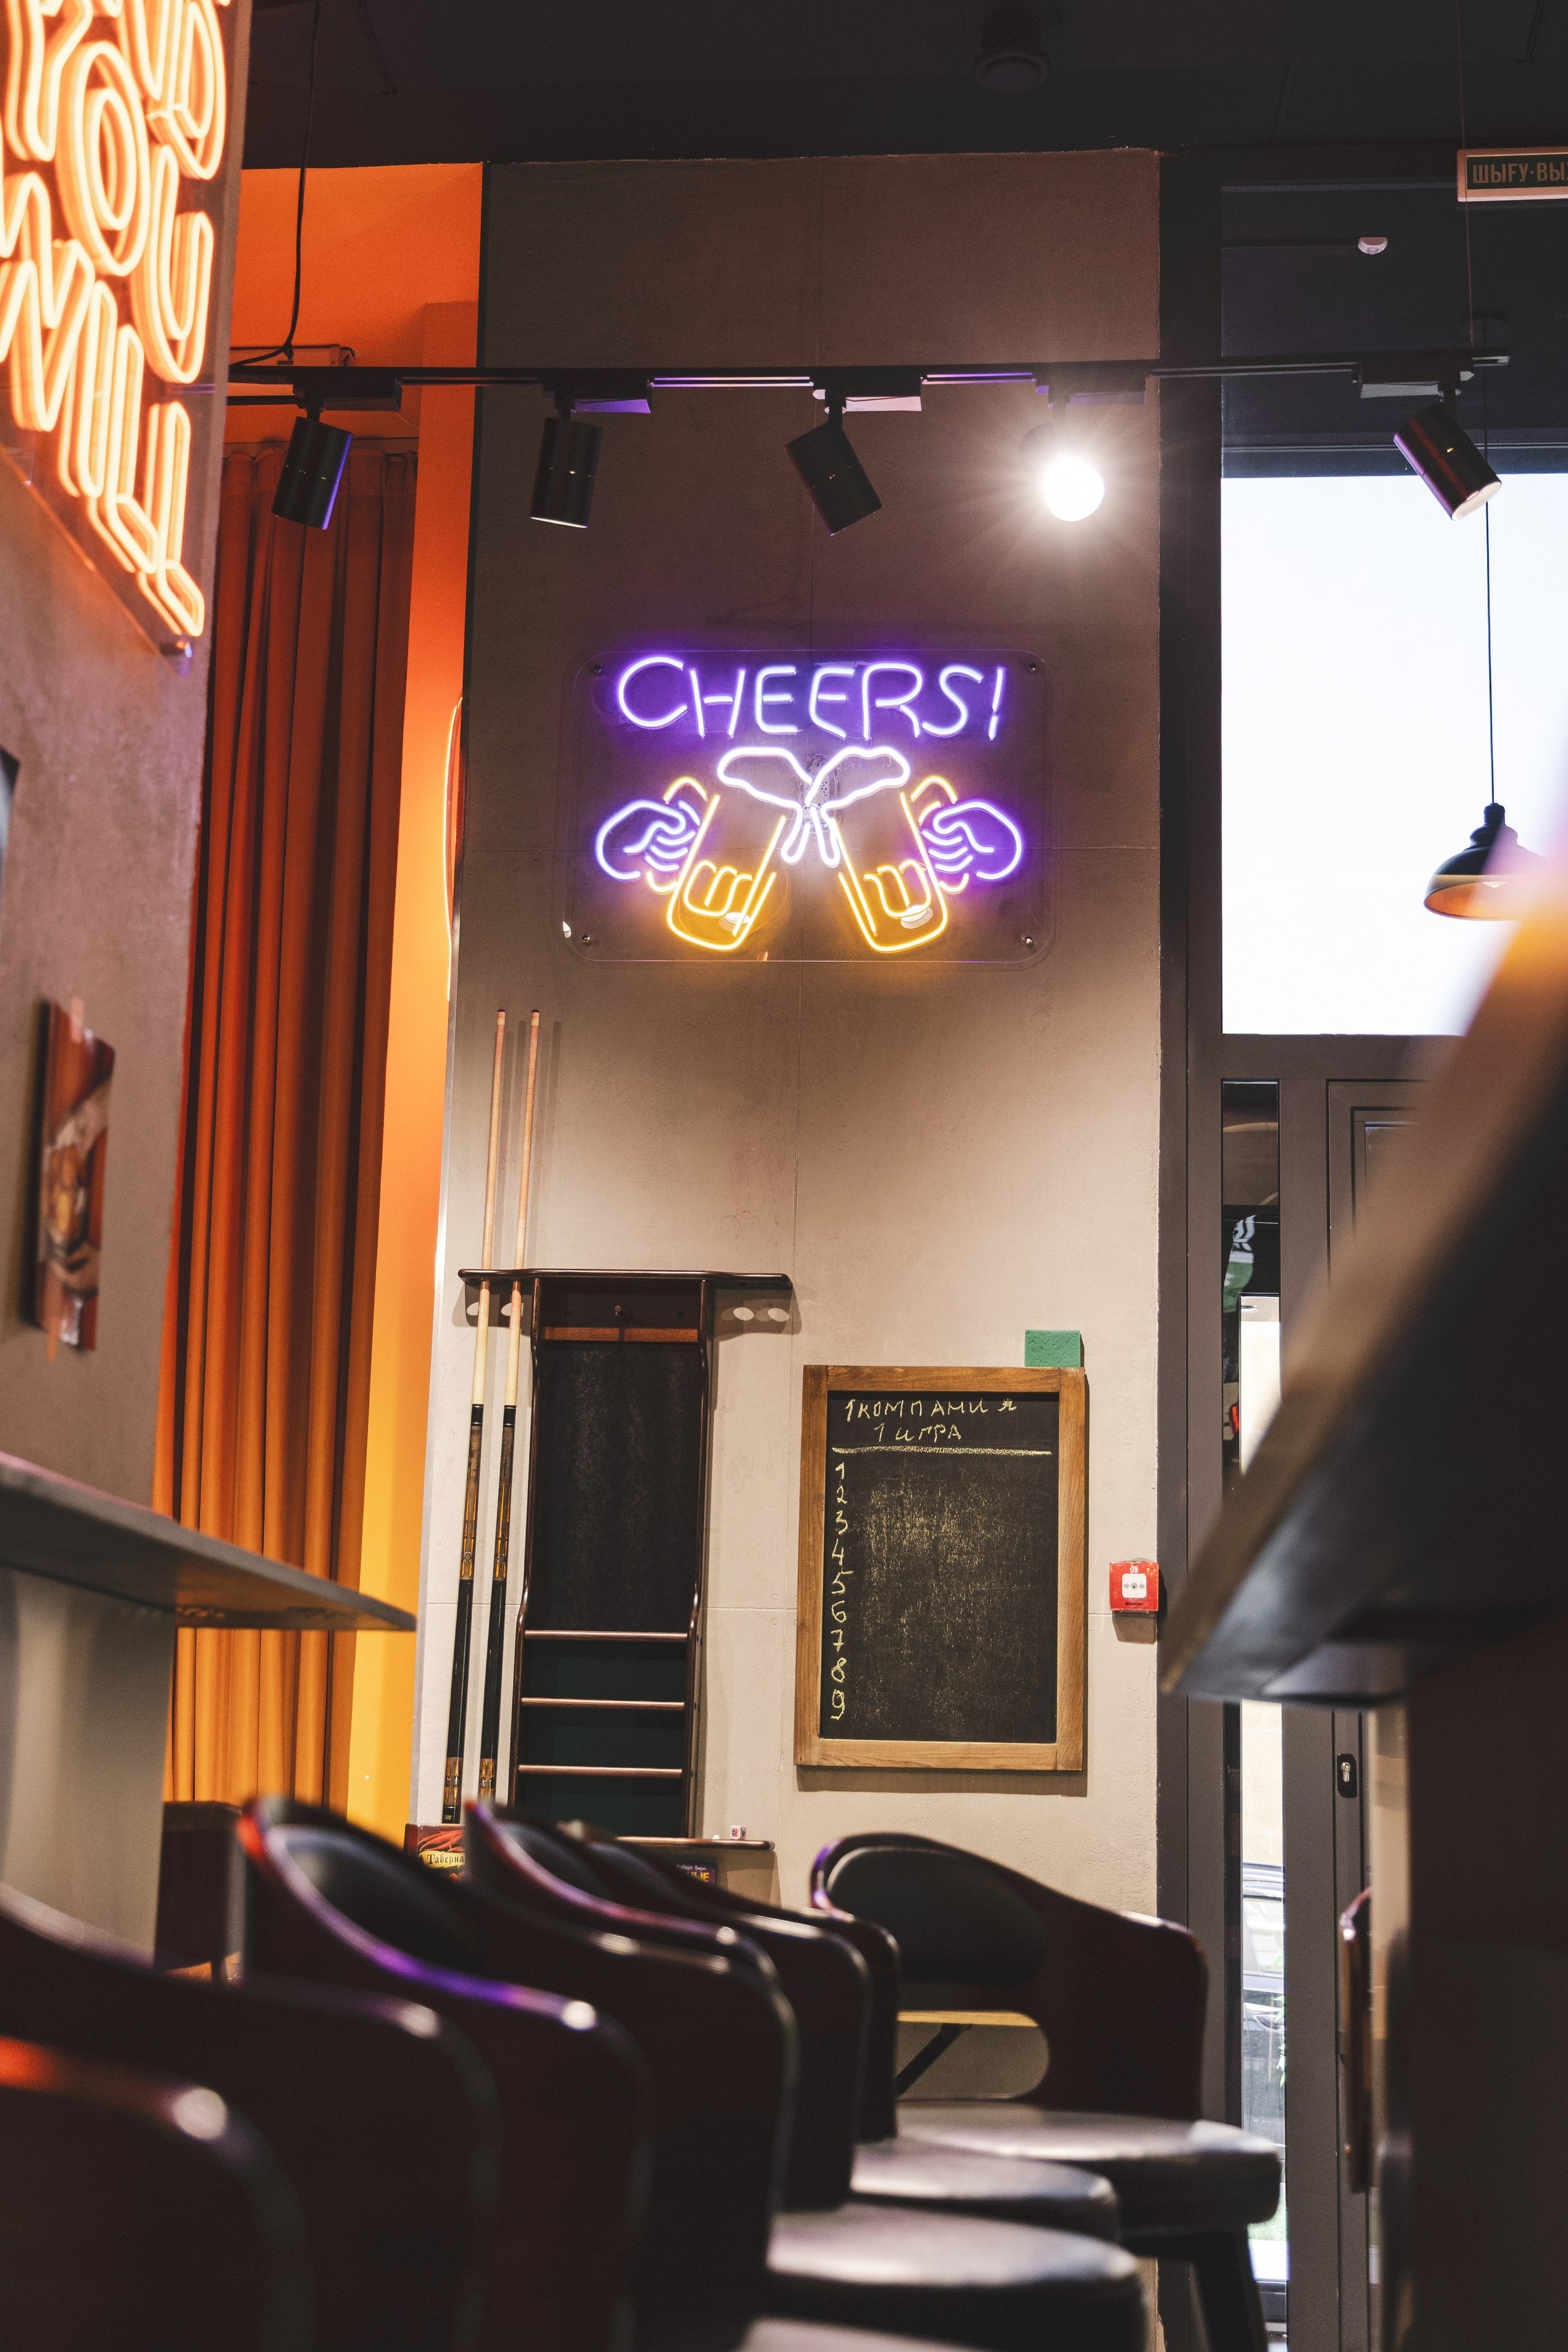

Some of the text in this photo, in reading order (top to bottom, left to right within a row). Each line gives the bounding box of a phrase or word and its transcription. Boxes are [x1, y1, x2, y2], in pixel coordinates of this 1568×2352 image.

[617, 655, 1006, 741] CHEERS!
[874, 1422, 885, 1442] 1
[835, 1461, 845, 1480] 1
[836, 1484, 848, 1504] 2
[835, 1512, 848, 1535] 3
[831, 1539, 845, 1566] 4
[831, 1570, 854, 1595] 5
[831, 1600, 847, 1623] 6
[831, 1629, 845, 1652] 7
[831, 1657, 847, 1683] 8
[830, 1688, 845, 1721] 9
